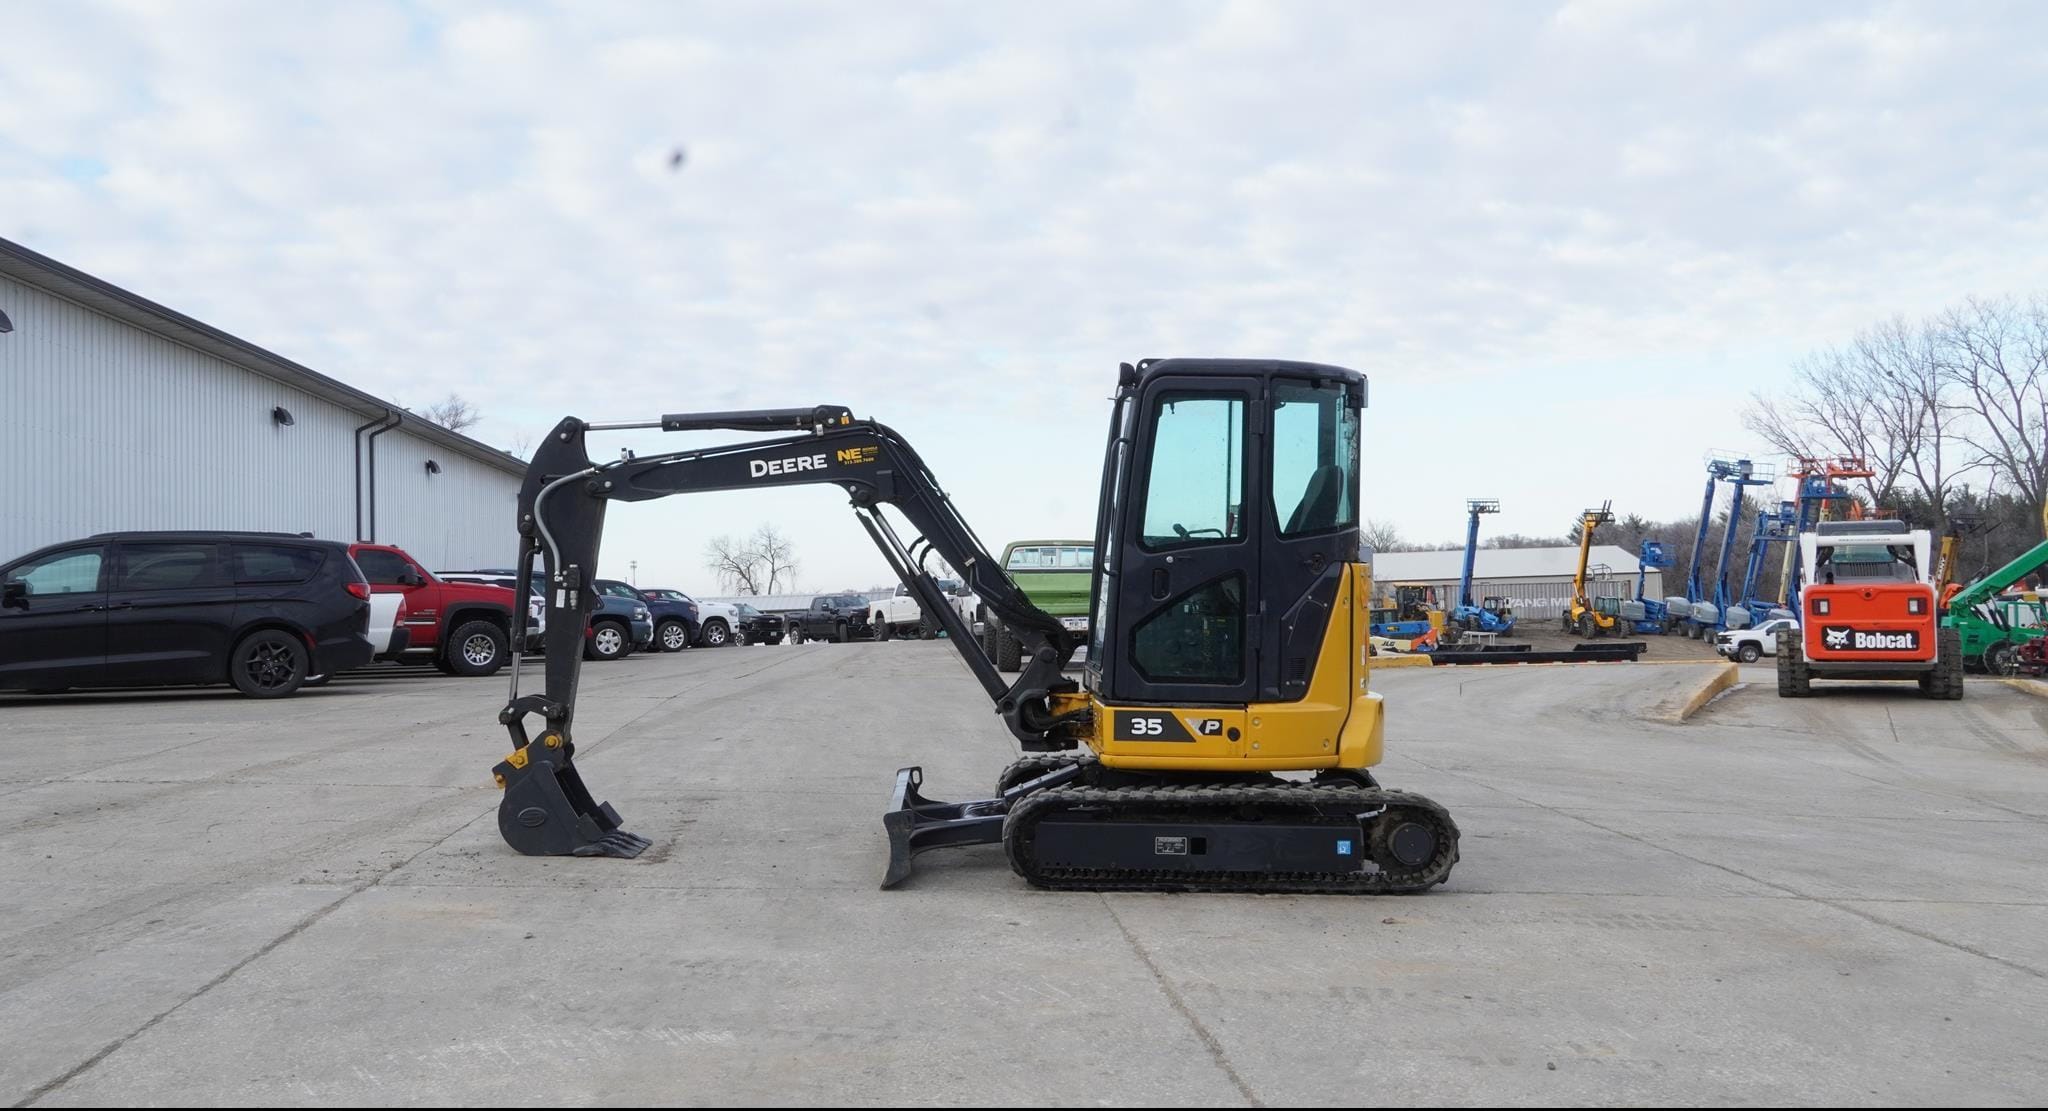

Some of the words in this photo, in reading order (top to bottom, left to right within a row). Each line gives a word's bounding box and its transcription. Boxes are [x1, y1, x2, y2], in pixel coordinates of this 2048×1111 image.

[837, 448, 862, 461] NE
[750, 454, 827, 478] DEERE
[1855, 632, 1913, 648] Bobcat
[1131, 718, 1163, 735] 35
